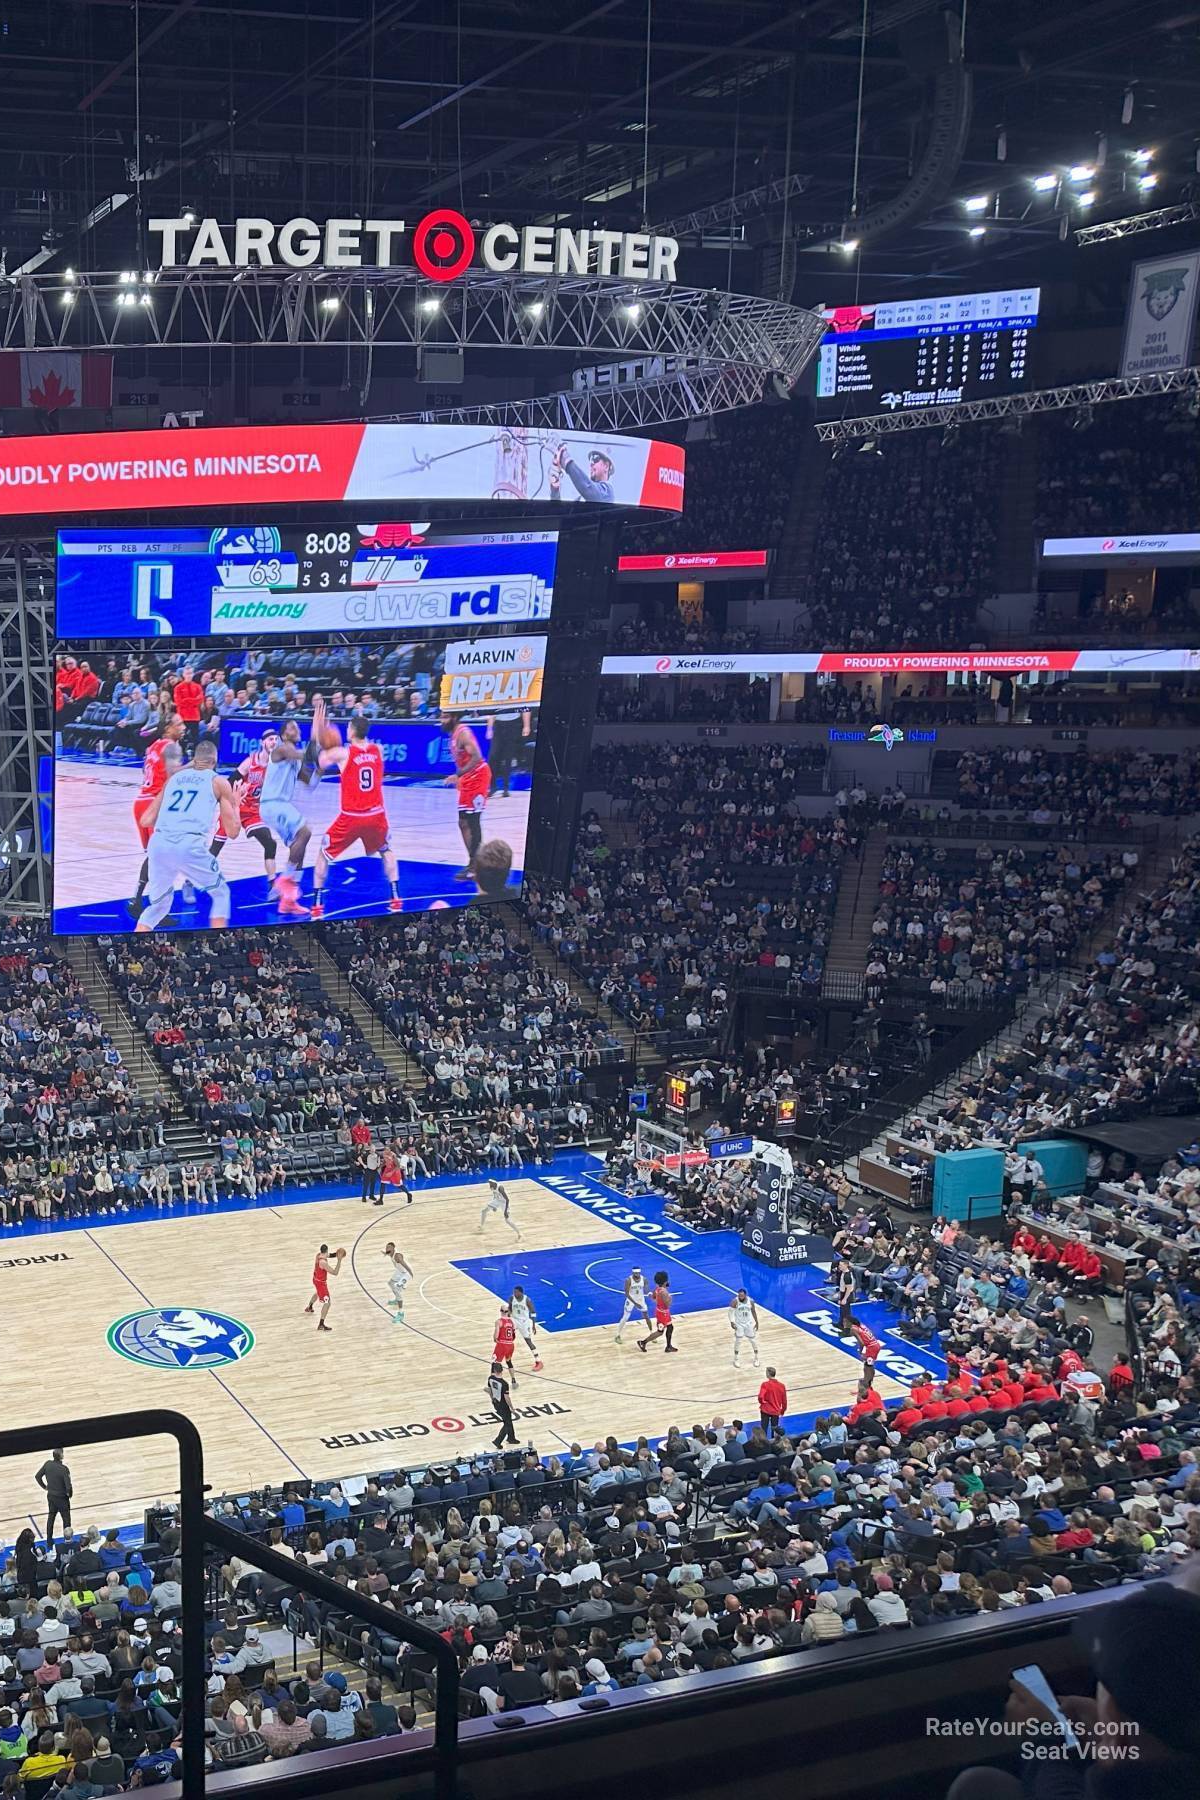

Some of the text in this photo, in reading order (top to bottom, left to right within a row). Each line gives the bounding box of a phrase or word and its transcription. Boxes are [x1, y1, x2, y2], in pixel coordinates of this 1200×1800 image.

[149, 217, 679, 282] TARGET CENTER
[960, 310, 971, 318] 22
[903, 390, 936, 402] Treasure
[937, 386, 963, 399] Island
[67, 458, 189, 483] POWERING
[193, 453, 322, 477] MINNESOTA
[304, 532, 352, 555] 8:08
[482, 532, 550, 544] PTS REB AST PF
[97, 544, 113, 553] PTS
[121, 544, 137, 553] REB
[144, 544, 161, 553] AST
[249, 558, 282, 587] 63
[302, 561, 313, 569] TO
[339, 559, 349, 568] TO
[367, 555, 397, 582] 77
[302, 574, 311, 587] 5
[319, 571, 330, 588] 3
[338, 573, 347, 585] 4
[414, 561, 422, 572] 0
[214, 601, 308, 619] Anthony
[458, 650, 516, 666] MARVIN
[676, 655, 1049, 670] Xcel Energy PROUDLY POWERING MINNESOTA
[449, 671, 537, 704] REPLAY
[829, 728, 937, 742] Treasure Island
[359, 766, 374, 792] 9
[168, 789, 199, 813] 27
[673, 1088, 684, 1107] 16
[727, 1143, 743, 1151] UHC
[538, 1175, 693, 1252] MINNESOTA
[742, 1239, 771, 1258] CFMOTO
[779, 1245, 806, 1255] TARGET
[779, 1251, 808, 1262] CENTER
[319, 1423, 431, 1449] CENTER
